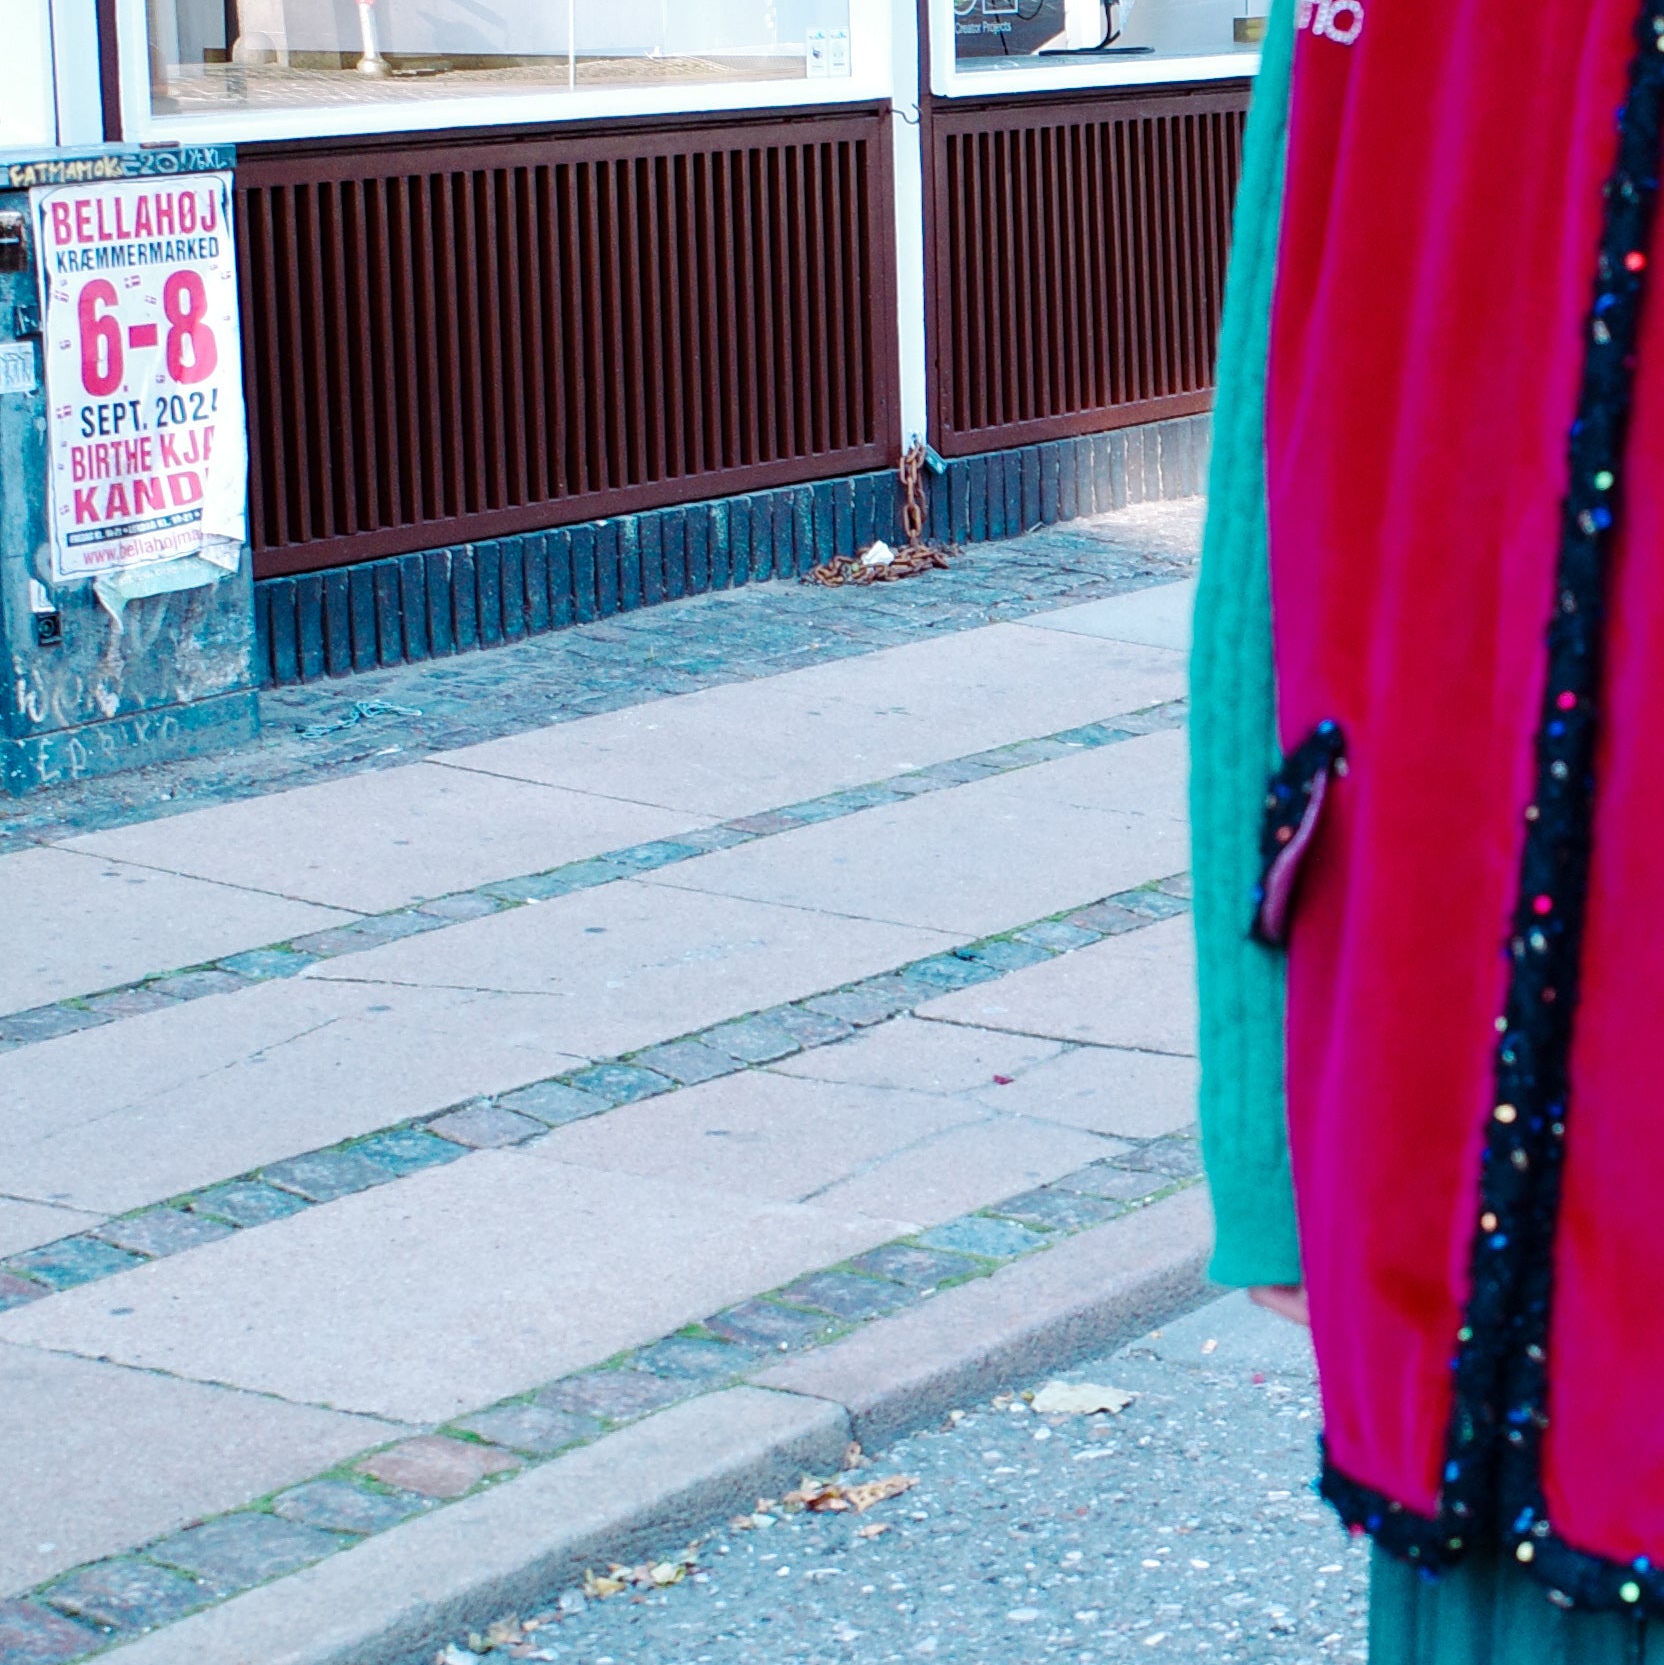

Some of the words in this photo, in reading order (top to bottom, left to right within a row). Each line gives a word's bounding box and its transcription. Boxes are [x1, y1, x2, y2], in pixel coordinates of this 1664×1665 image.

[51, 189, 217, 246] BELLAHØJ
[56, 237, 219, 273] KRÆMMERMARKED
[81, 399, 147, 438] SEPT.
[71, 436, 152, 483] BIRTHE
